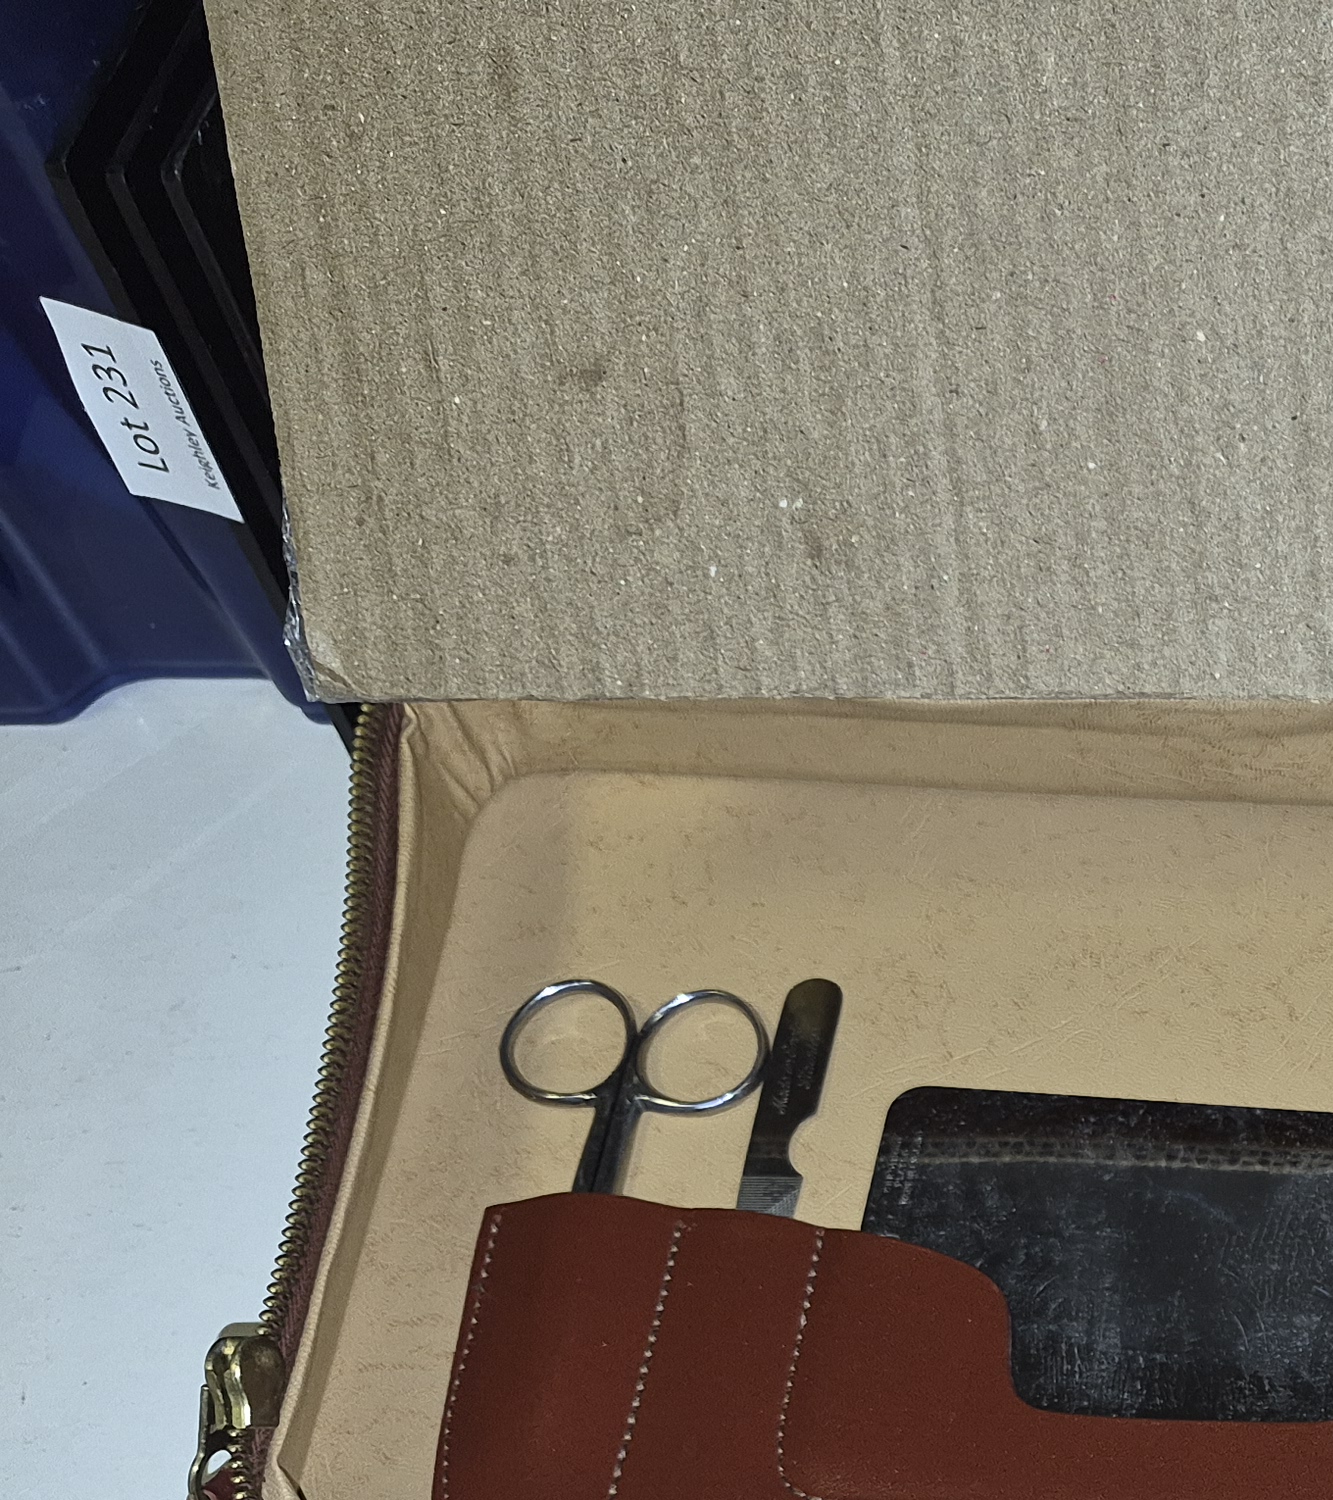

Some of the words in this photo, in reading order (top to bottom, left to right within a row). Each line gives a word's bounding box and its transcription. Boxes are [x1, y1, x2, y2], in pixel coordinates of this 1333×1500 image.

[80, 341, 141, 410] 231
[149, 358, 191, 428] Auctions
[119, 416, 171, 474] Lot
[181, 428, 221, 490] Keighley
